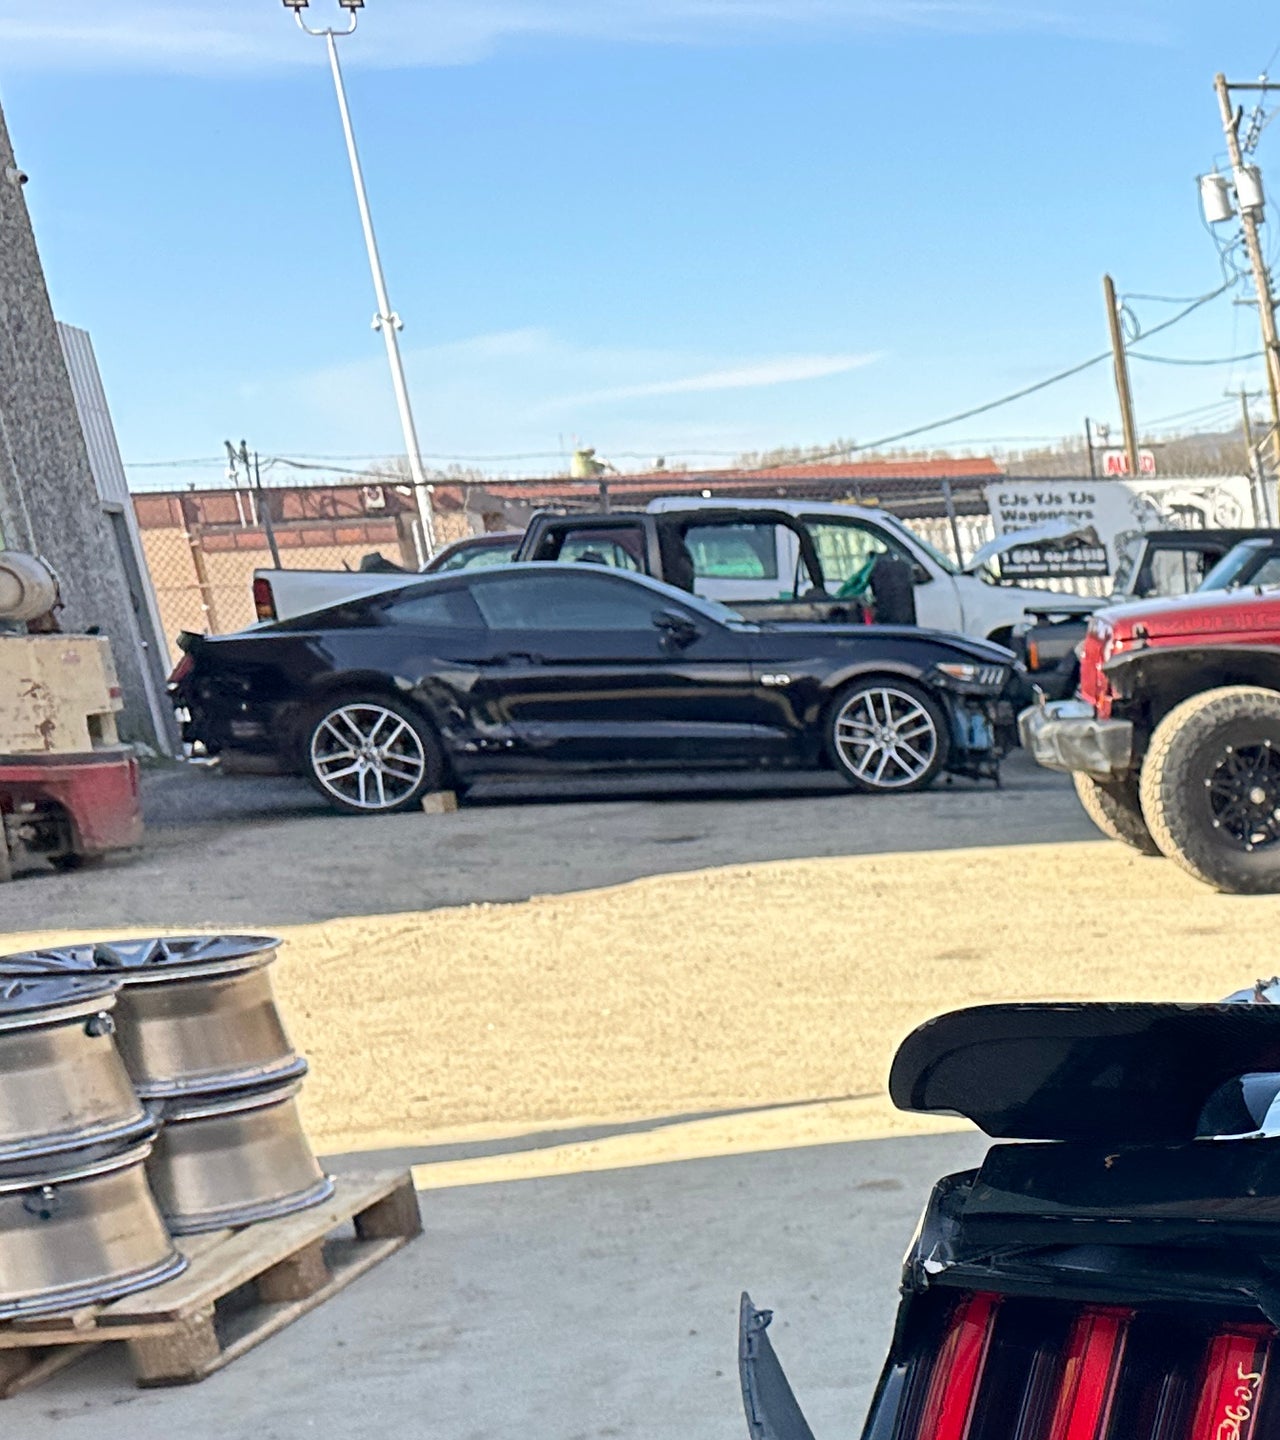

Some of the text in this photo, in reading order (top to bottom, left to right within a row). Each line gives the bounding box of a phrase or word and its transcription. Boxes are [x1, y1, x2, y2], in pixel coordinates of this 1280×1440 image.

[999, 491, 1095, 507] CJs YJs TJs
